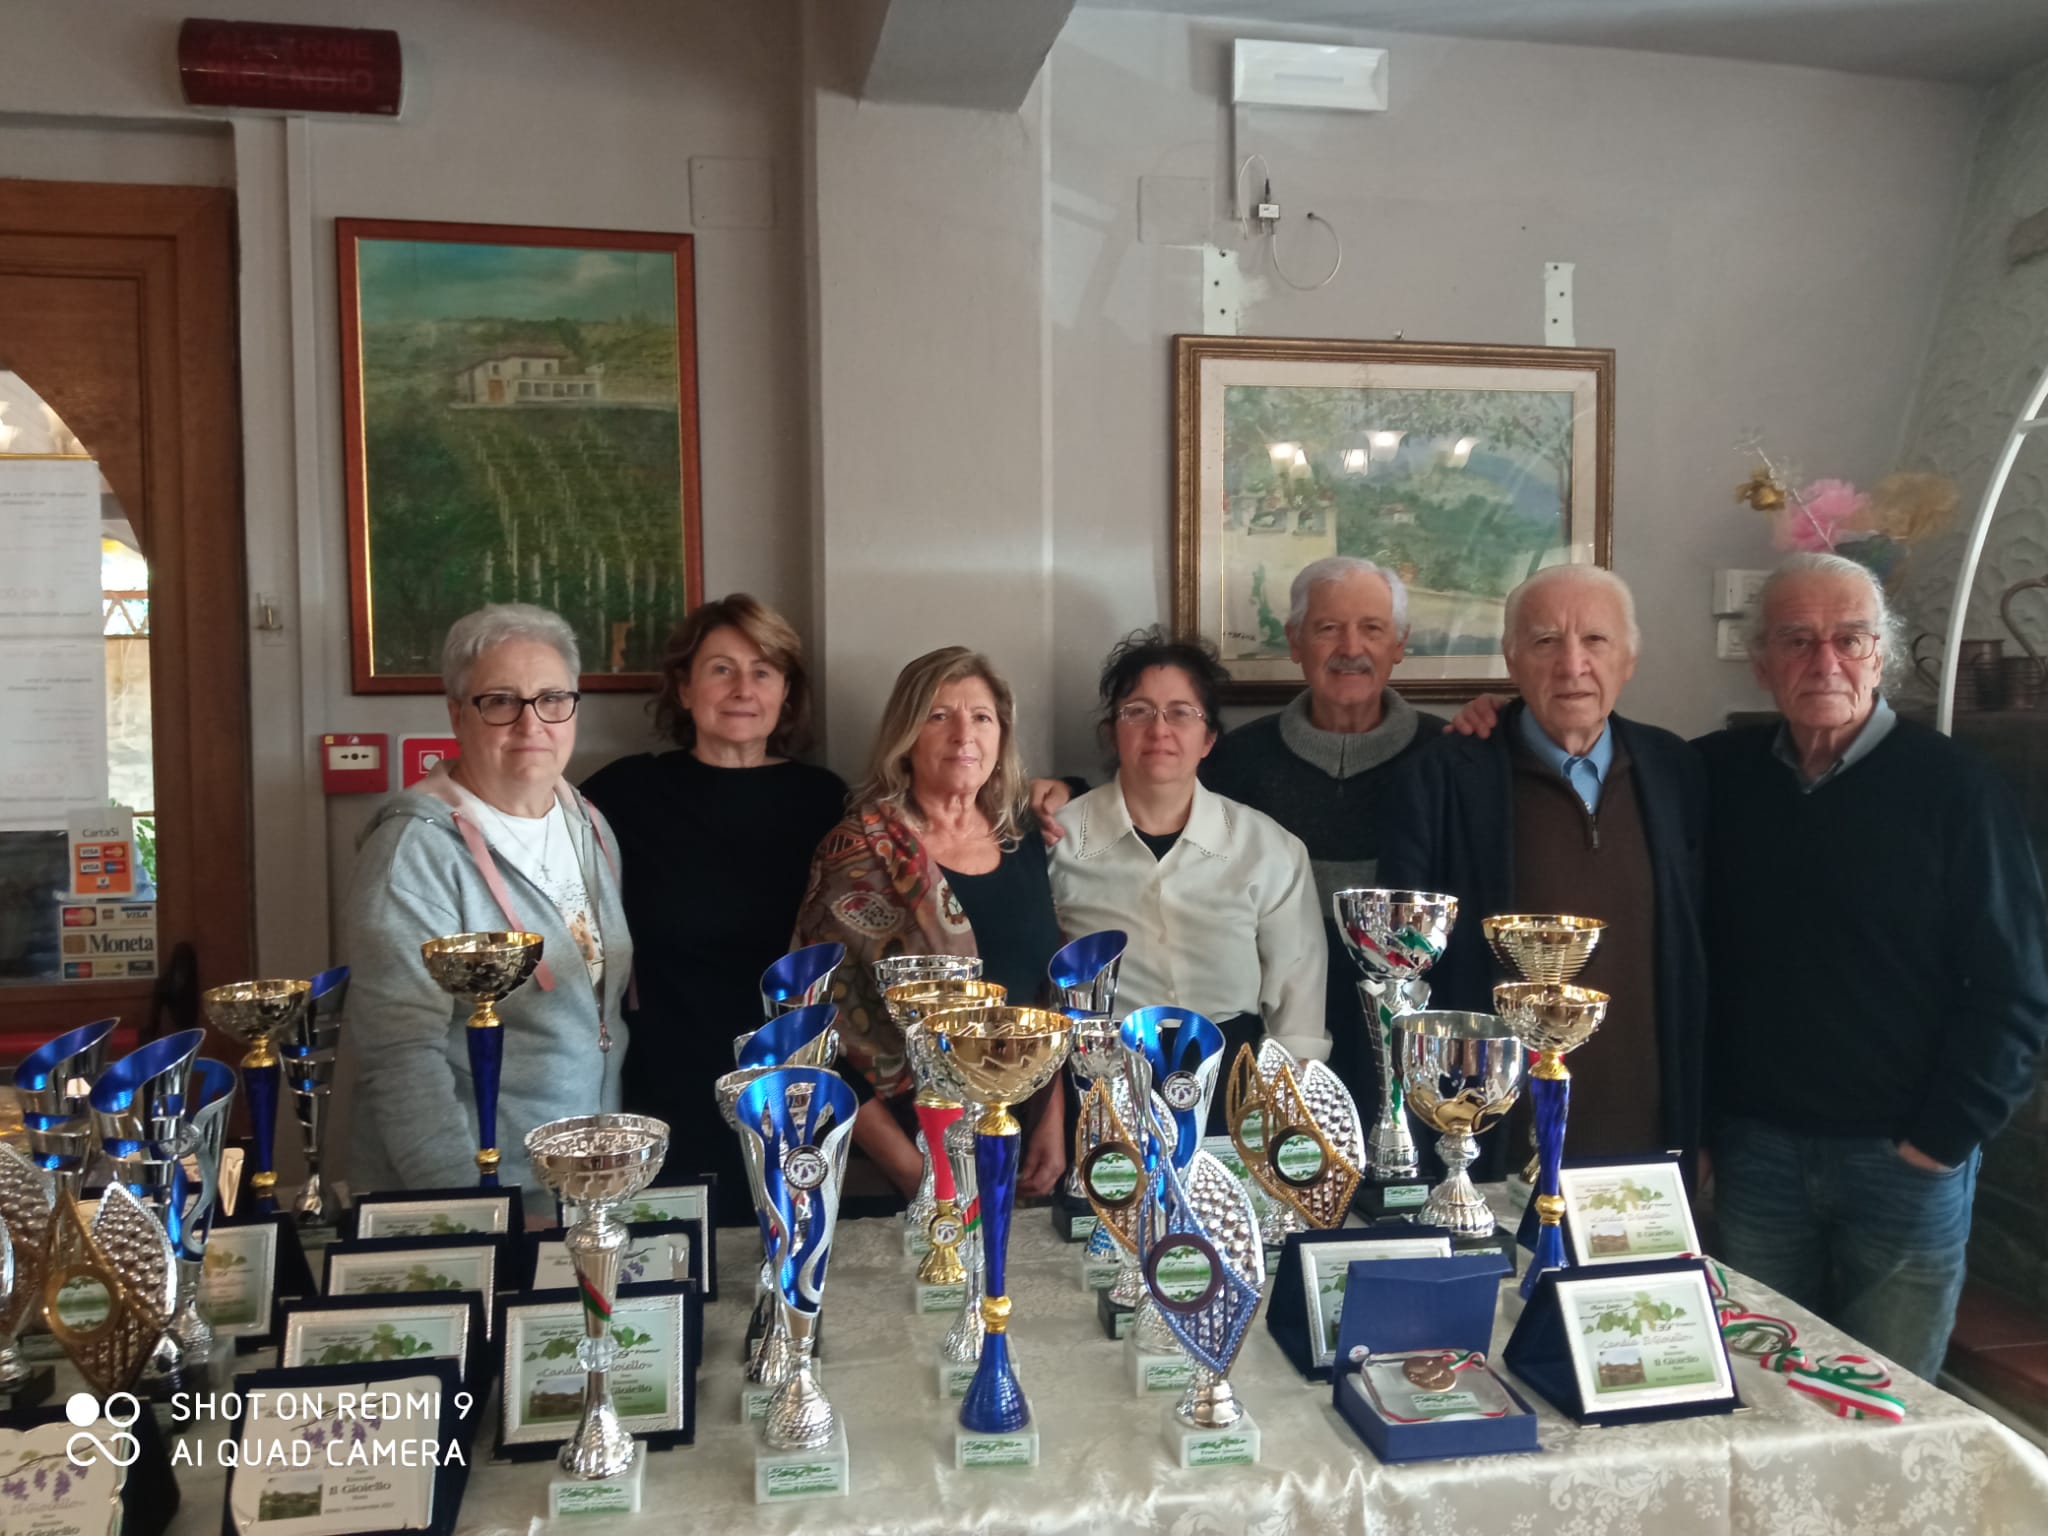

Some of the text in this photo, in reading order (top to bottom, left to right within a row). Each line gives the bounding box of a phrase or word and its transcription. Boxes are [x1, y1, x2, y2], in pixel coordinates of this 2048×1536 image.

[207, 61, 374, 94] INCENDIO
[126, 911, 149, 919] VISA
[88, 933, 154, 954] Moneta
[341, 1481, 392, 1495] Gioiello
